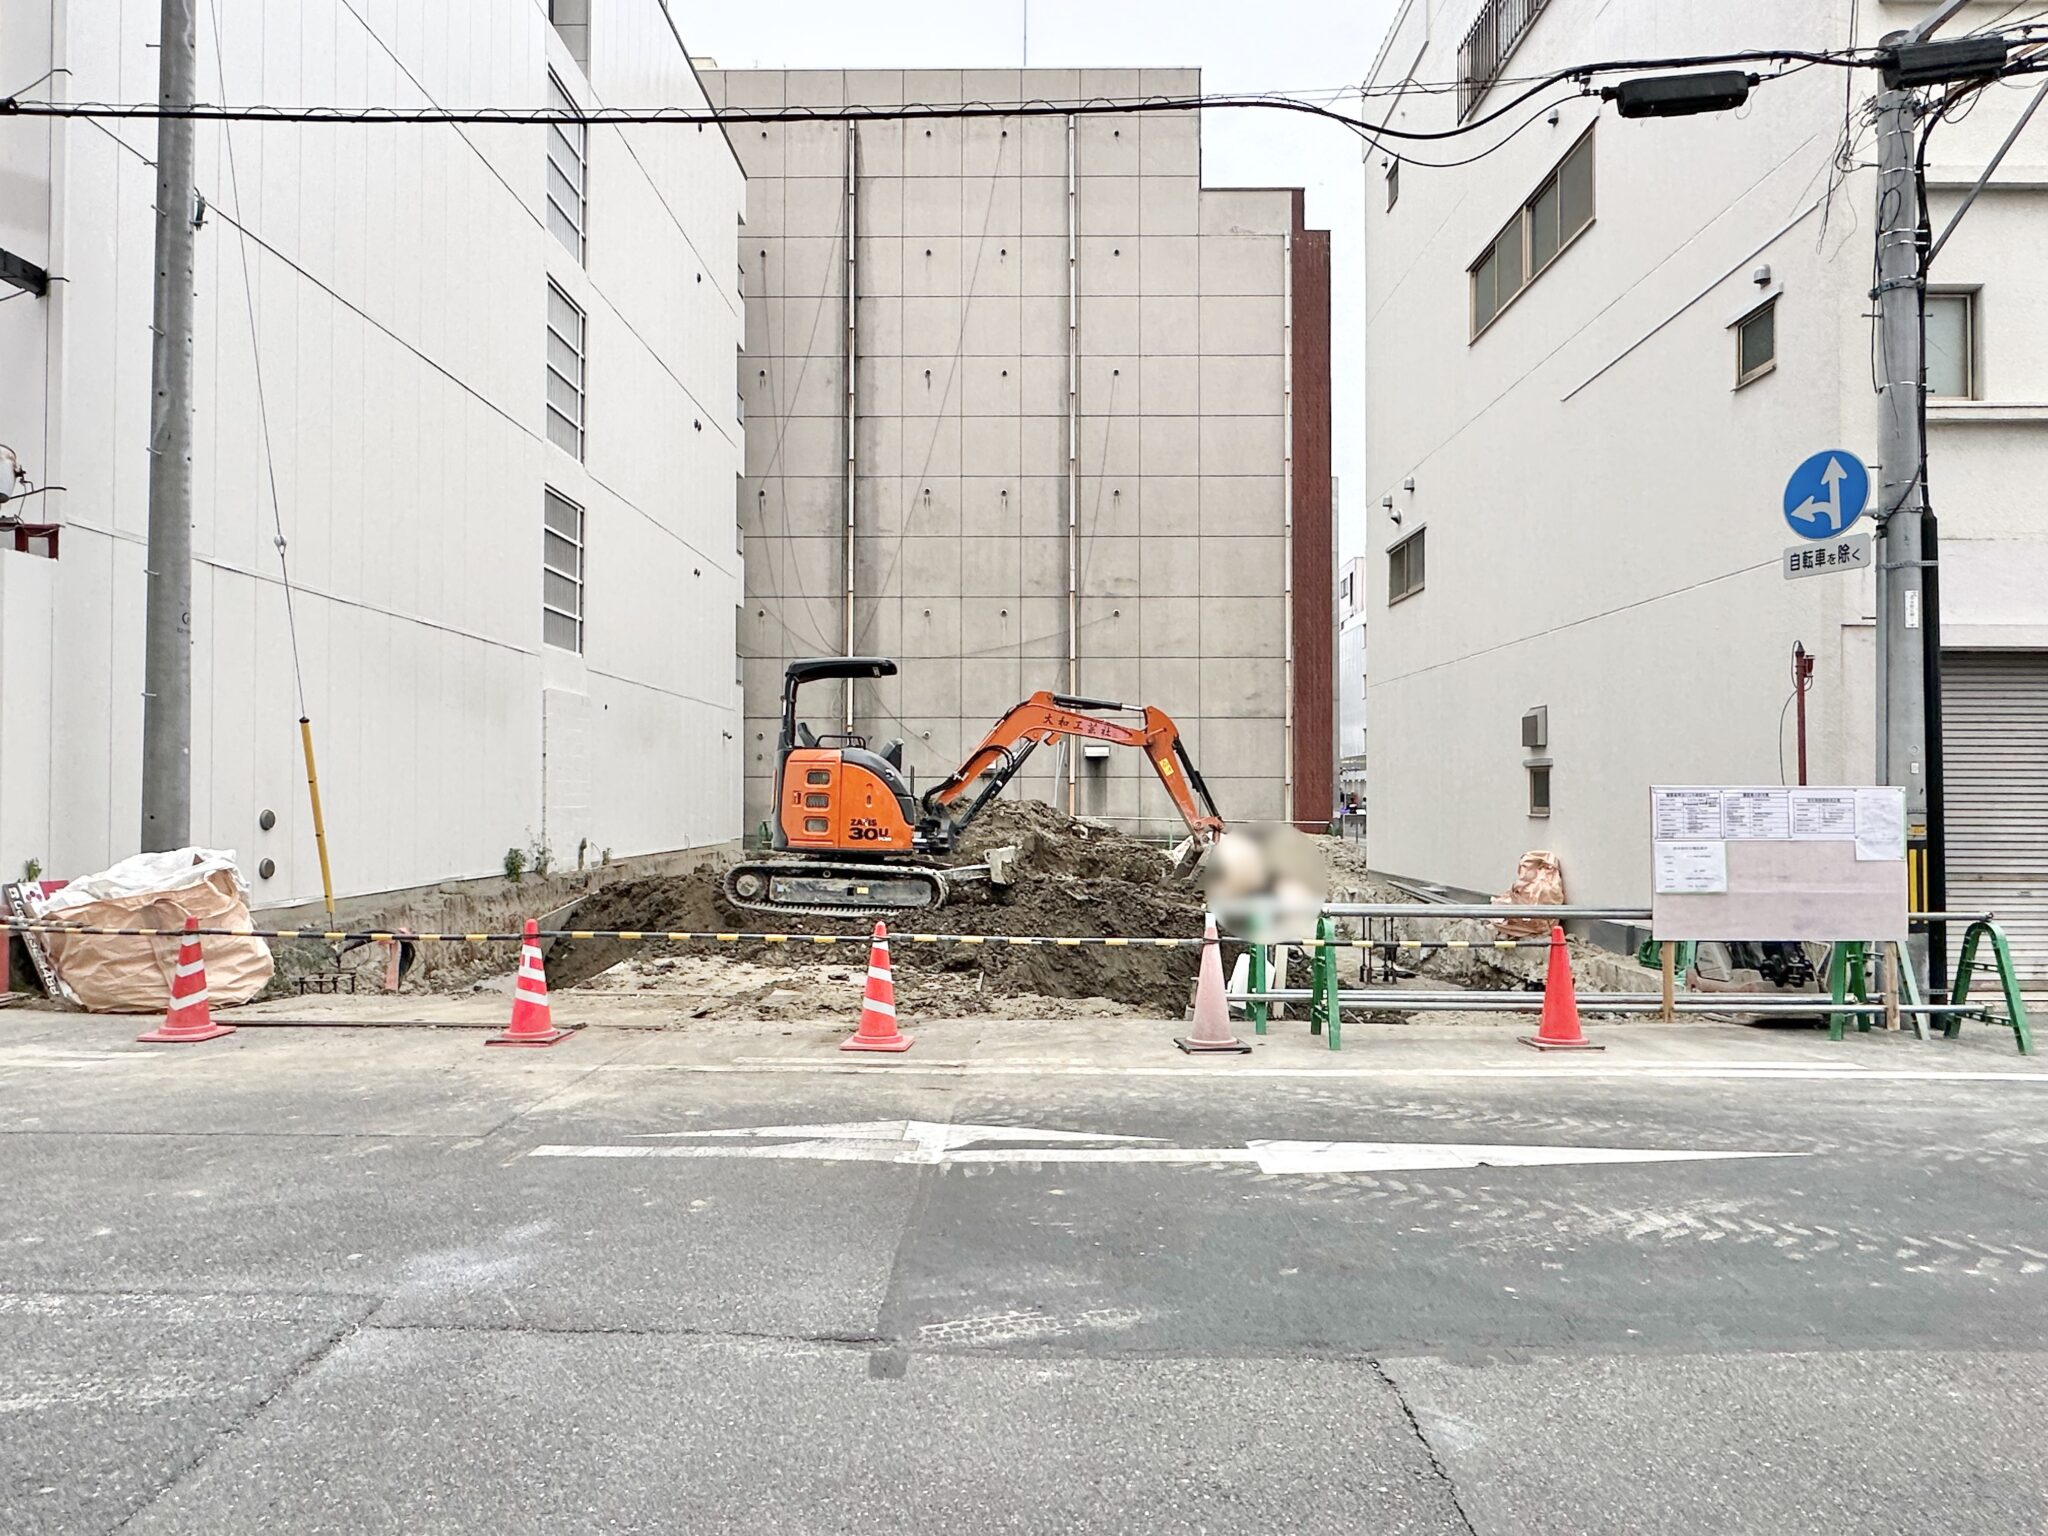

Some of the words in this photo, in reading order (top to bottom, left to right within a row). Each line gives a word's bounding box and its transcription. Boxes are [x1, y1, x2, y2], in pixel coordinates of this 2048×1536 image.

[1790, 543, 1860, 571] 自転車を除く
